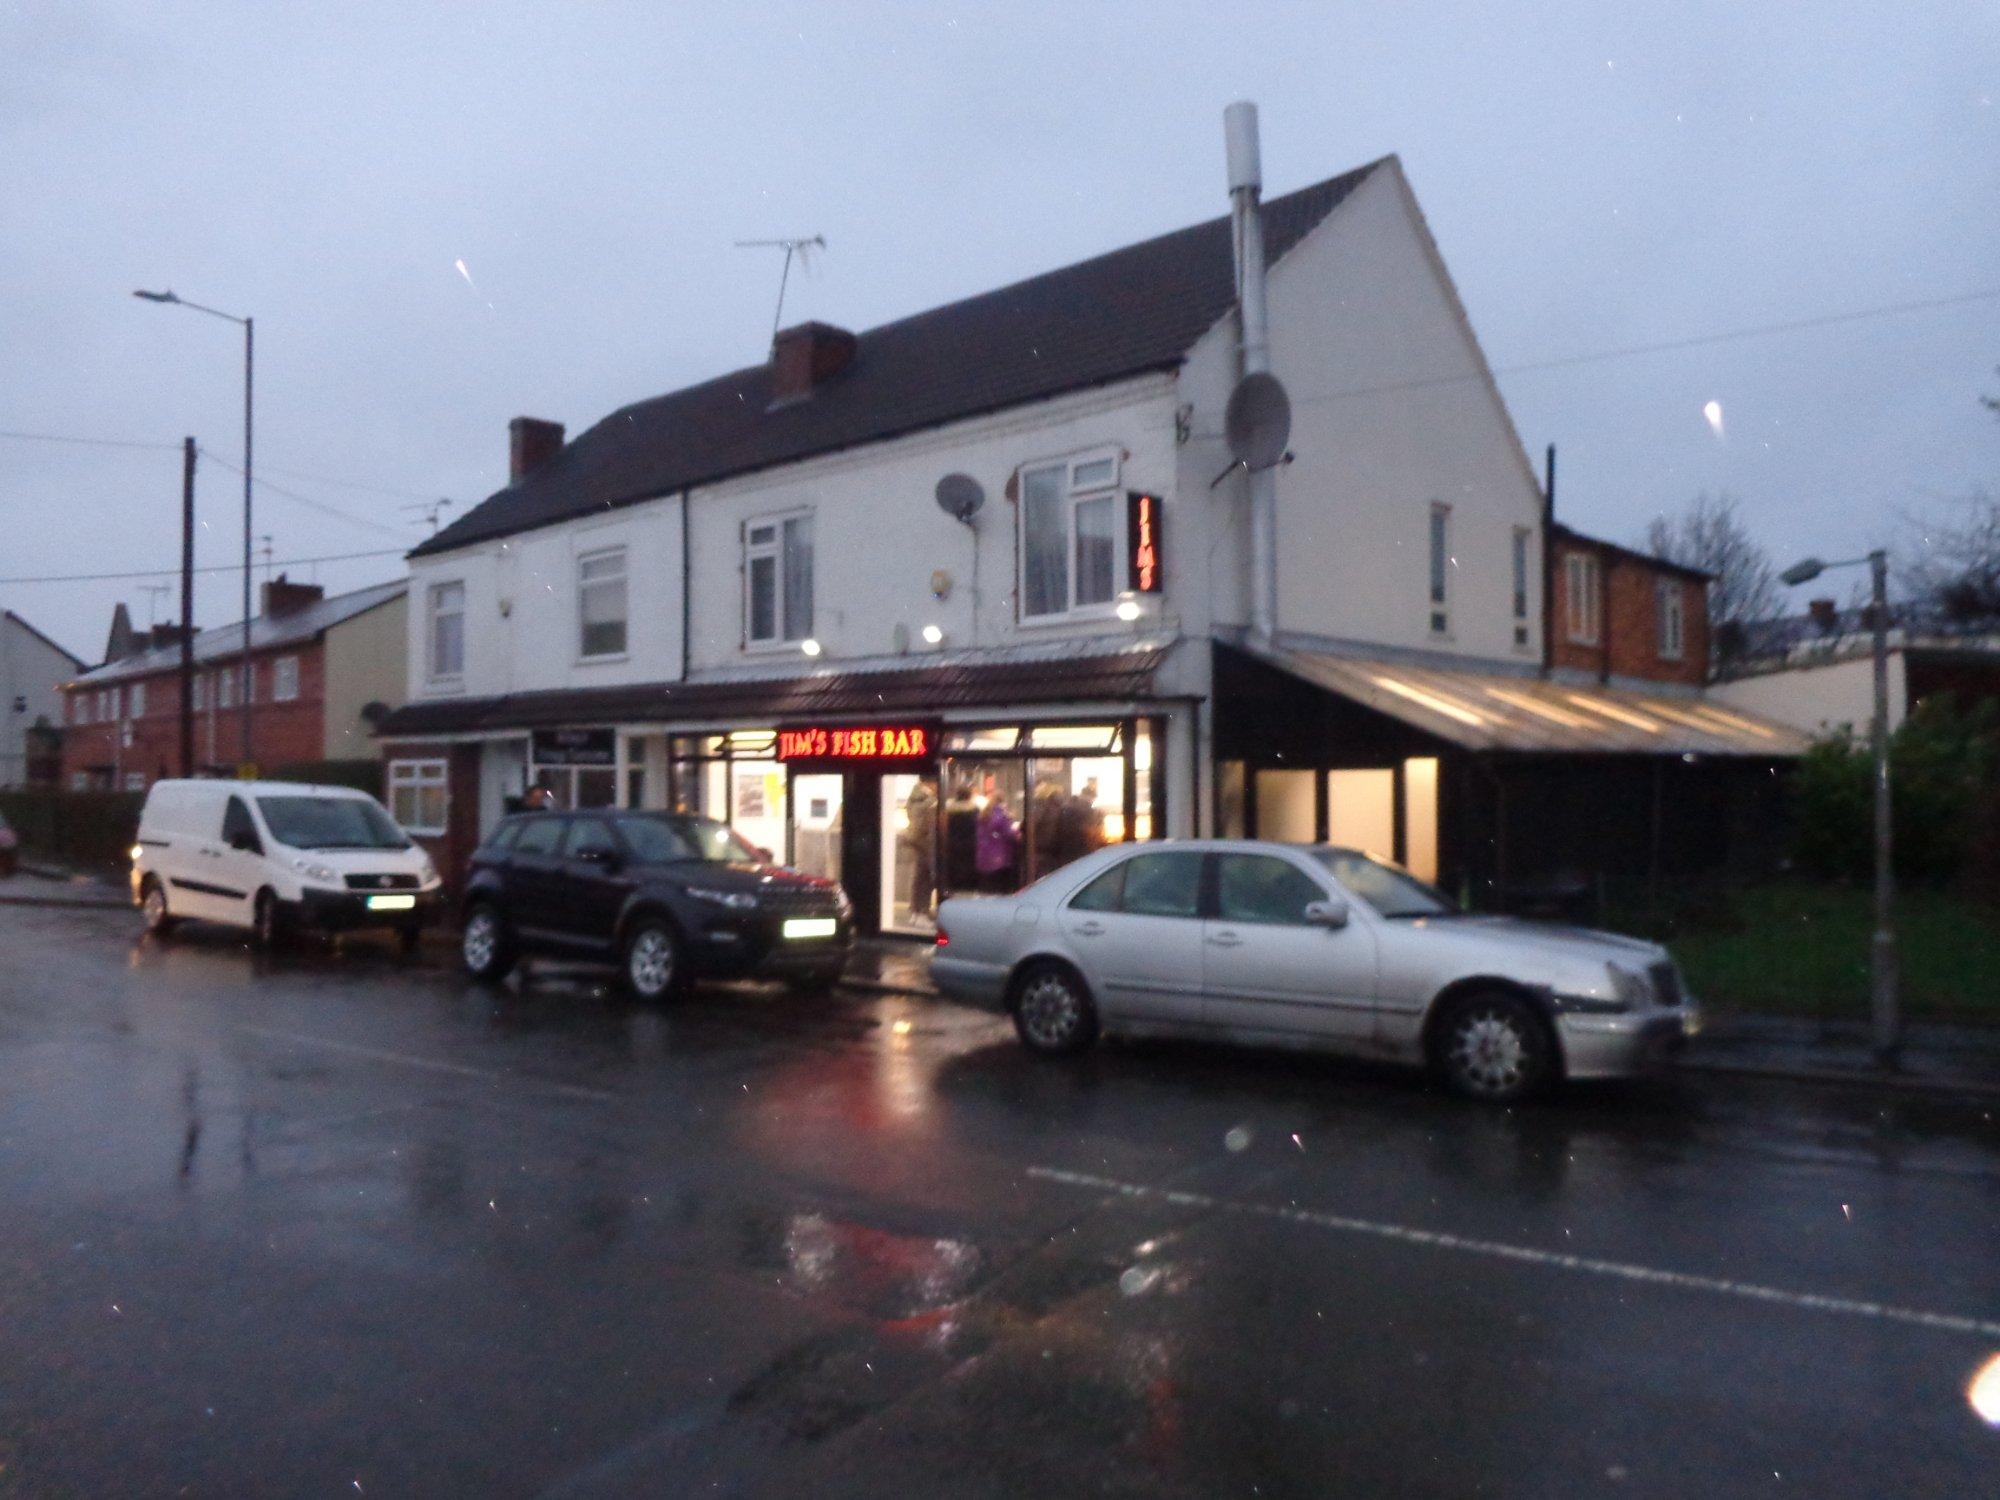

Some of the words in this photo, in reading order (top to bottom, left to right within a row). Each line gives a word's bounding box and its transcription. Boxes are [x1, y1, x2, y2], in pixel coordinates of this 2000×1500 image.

[779, 728, 828, 759] JIM'S
[830, 730, 877, 756] FISH
[881, 729, 927, 756] BAR
